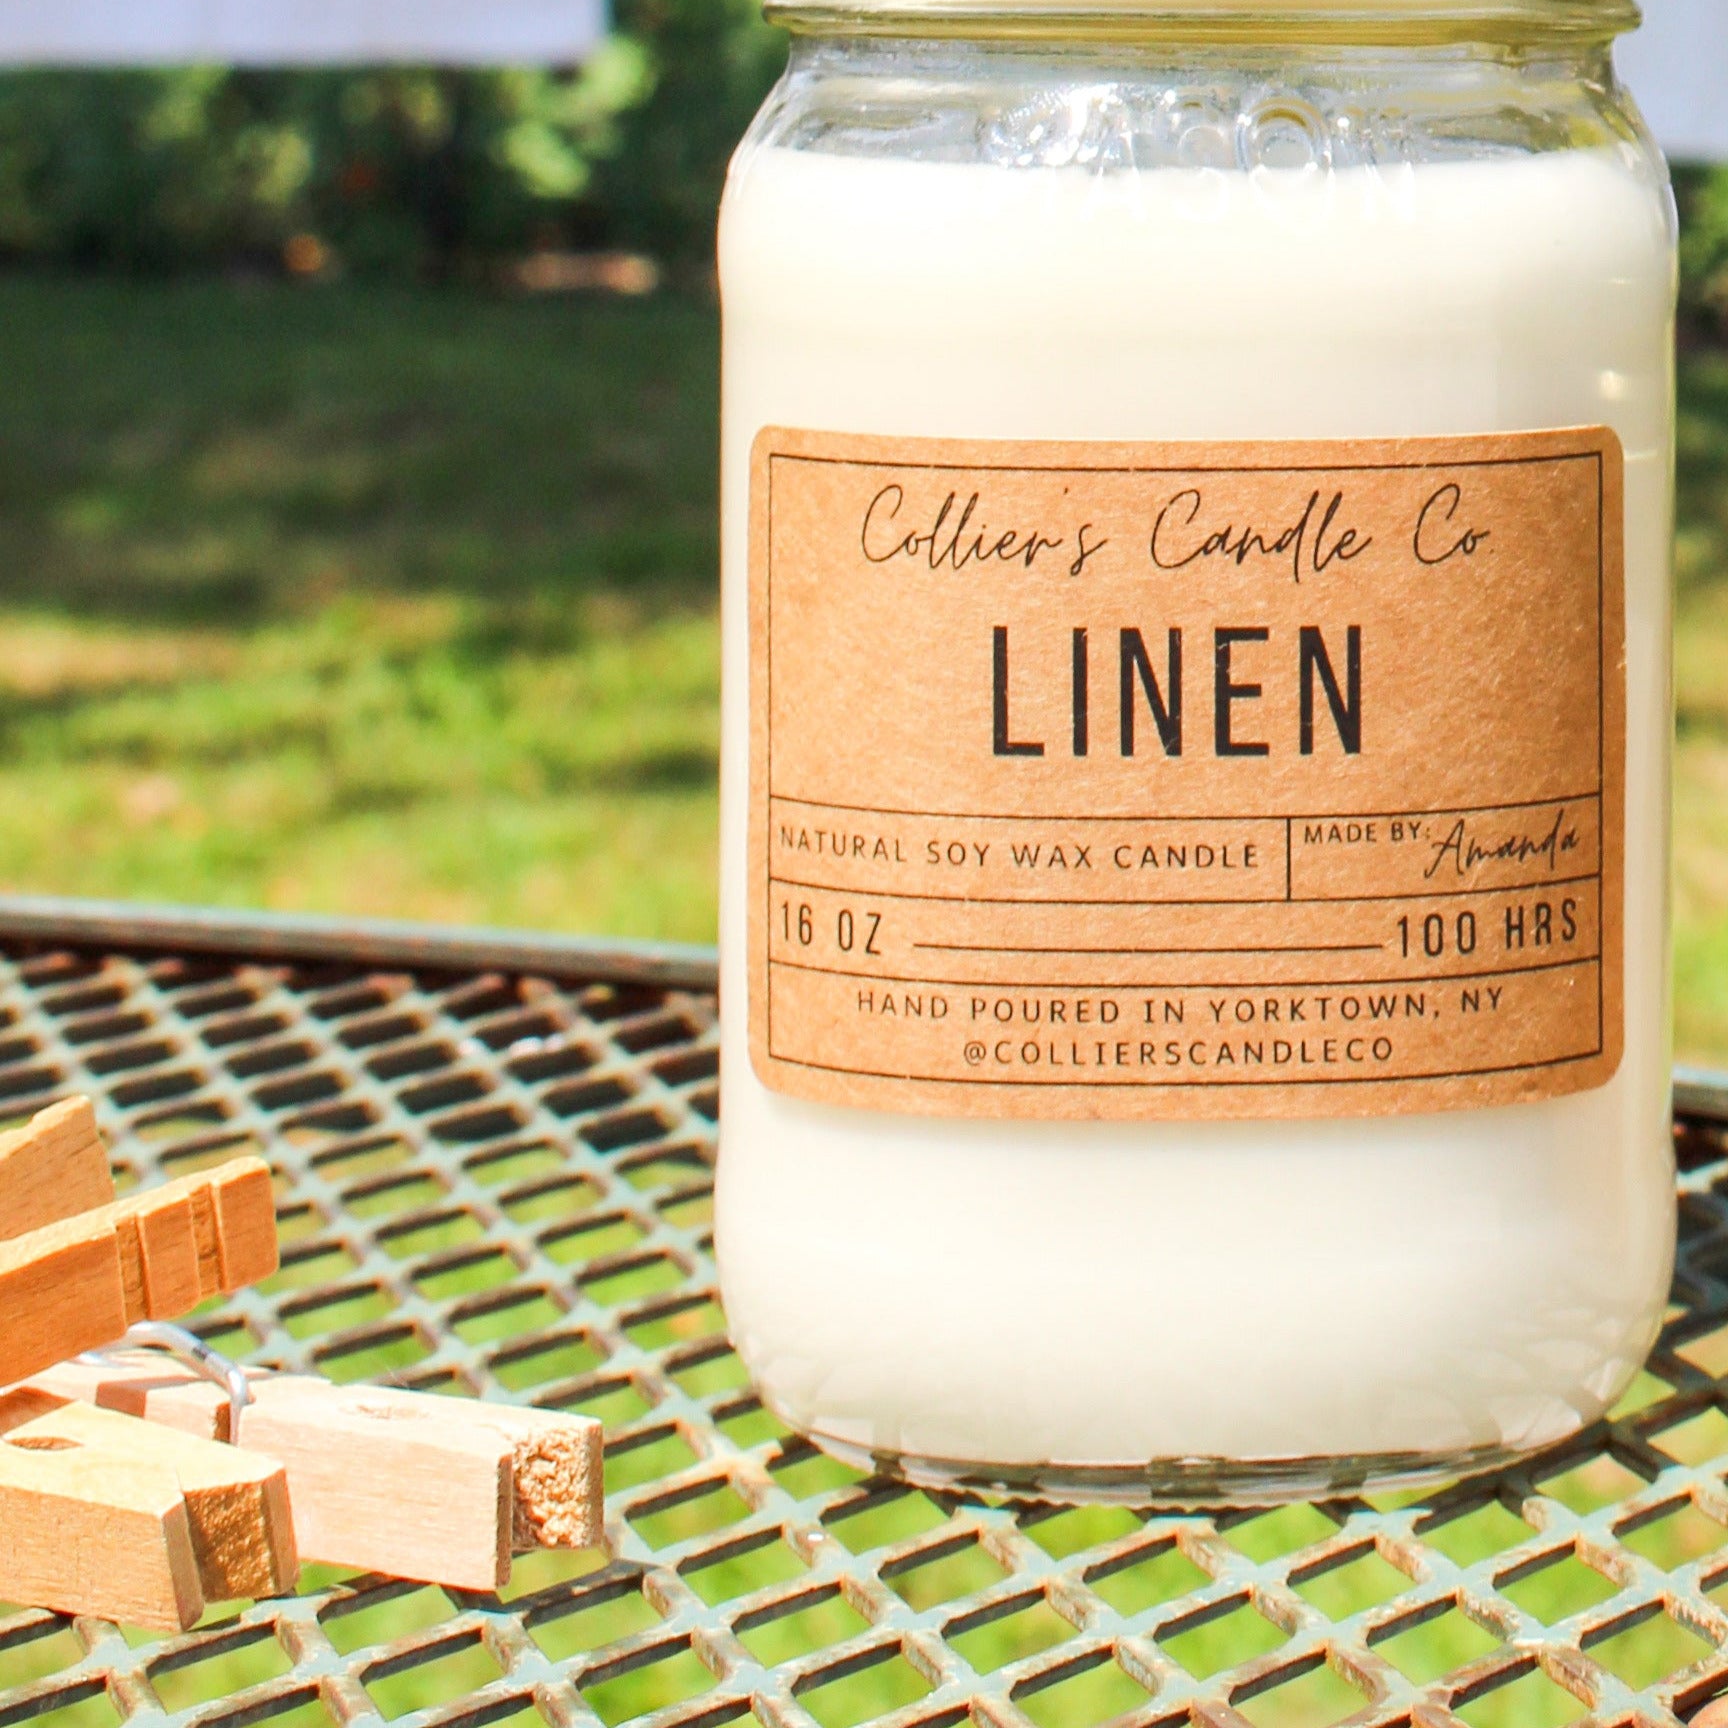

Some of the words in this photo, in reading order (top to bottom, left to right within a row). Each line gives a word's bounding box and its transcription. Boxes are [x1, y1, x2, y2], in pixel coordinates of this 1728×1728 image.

[860, 483, 1109, 578] Collier's
[1150, 488, 1373, 585] Candle
[993, 625, 1362, 757] LINEN
[780, 825, 907, 863] NATURAL
[926, 839, 990, 868] SOY
[1011, 843, 1092, 870] WAX
[1113, 843, 1259, 871] CANDLE
[1304, 822, 1377, 844] MADE
[1424, 808, 1580, 879] Amanda
[781, 900, 813, 947] 16
[837, 908, 882, 956] OZ
[1396, 910, 1477, 959] 100
[1504, 897, 1577, 950] HRS
[857, 990, 949, 1020] HAND
[971, 997, 1120, 1024] POURED
[1143, 999, 1184, 1024] IN
[1209, 992, 1440, 1024] YORKTOWN,
[1460, 986, 1503, 1014] NY
[963, 1036, 1393, 1067] @COLLIERSCANDLECO
